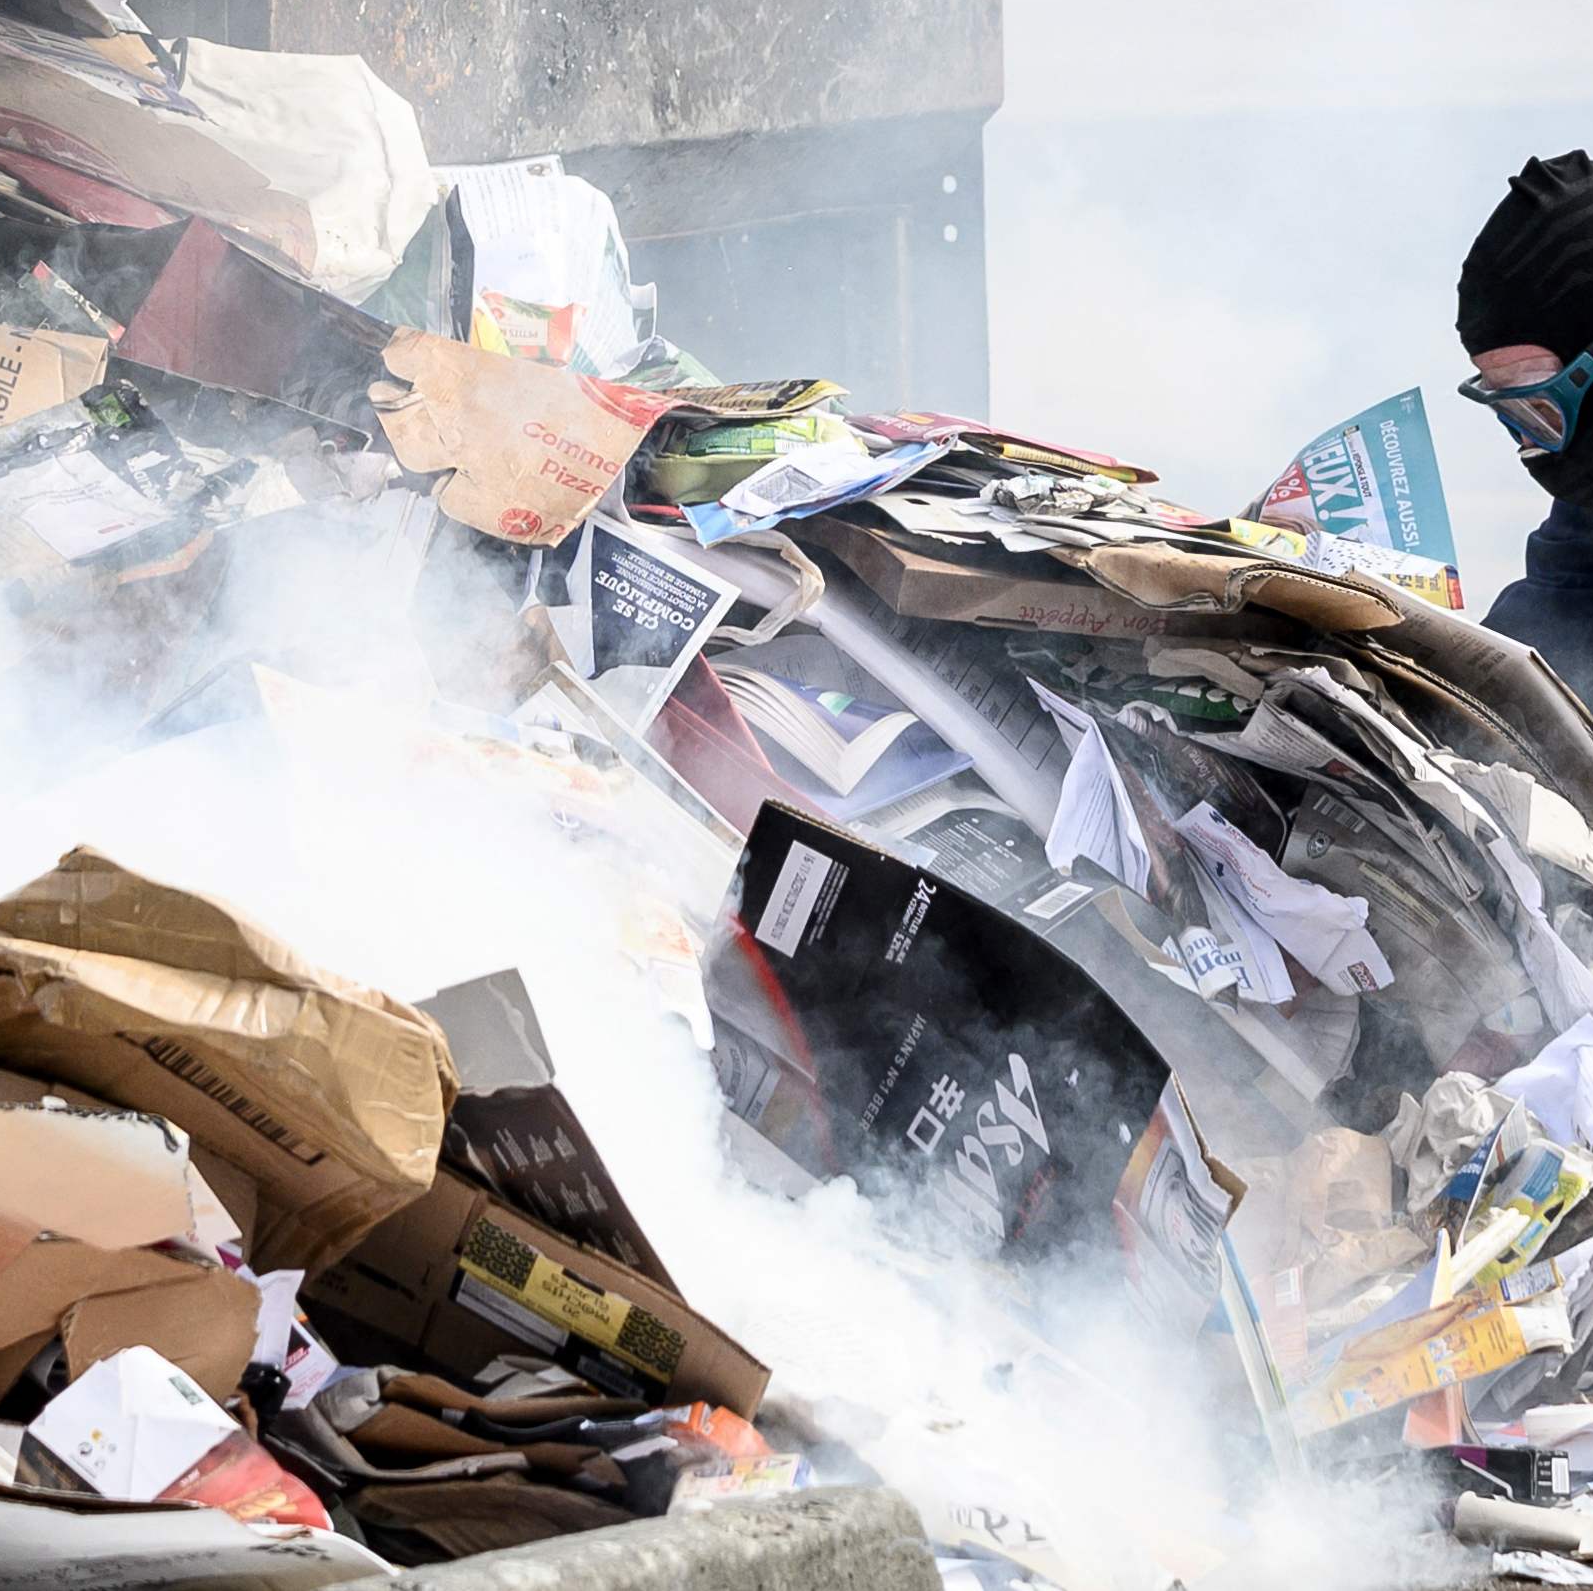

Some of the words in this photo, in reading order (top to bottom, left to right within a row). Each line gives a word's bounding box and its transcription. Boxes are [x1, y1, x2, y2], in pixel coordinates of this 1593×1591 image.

[1379, 419, 1410, 497] DÉCOUVREZ
[595, 570, 695, 631] COMPLIQUE
[612, 599, 636, 618] SE
[635, 613, 659, 630] ÇA
[912, 877, 938, 904] 24
[895, 1013, 928, 1068] JAPAN'S
[859, 1095, 884, 1132] BEER
[906, 1074, 965, 1154] 辛口
